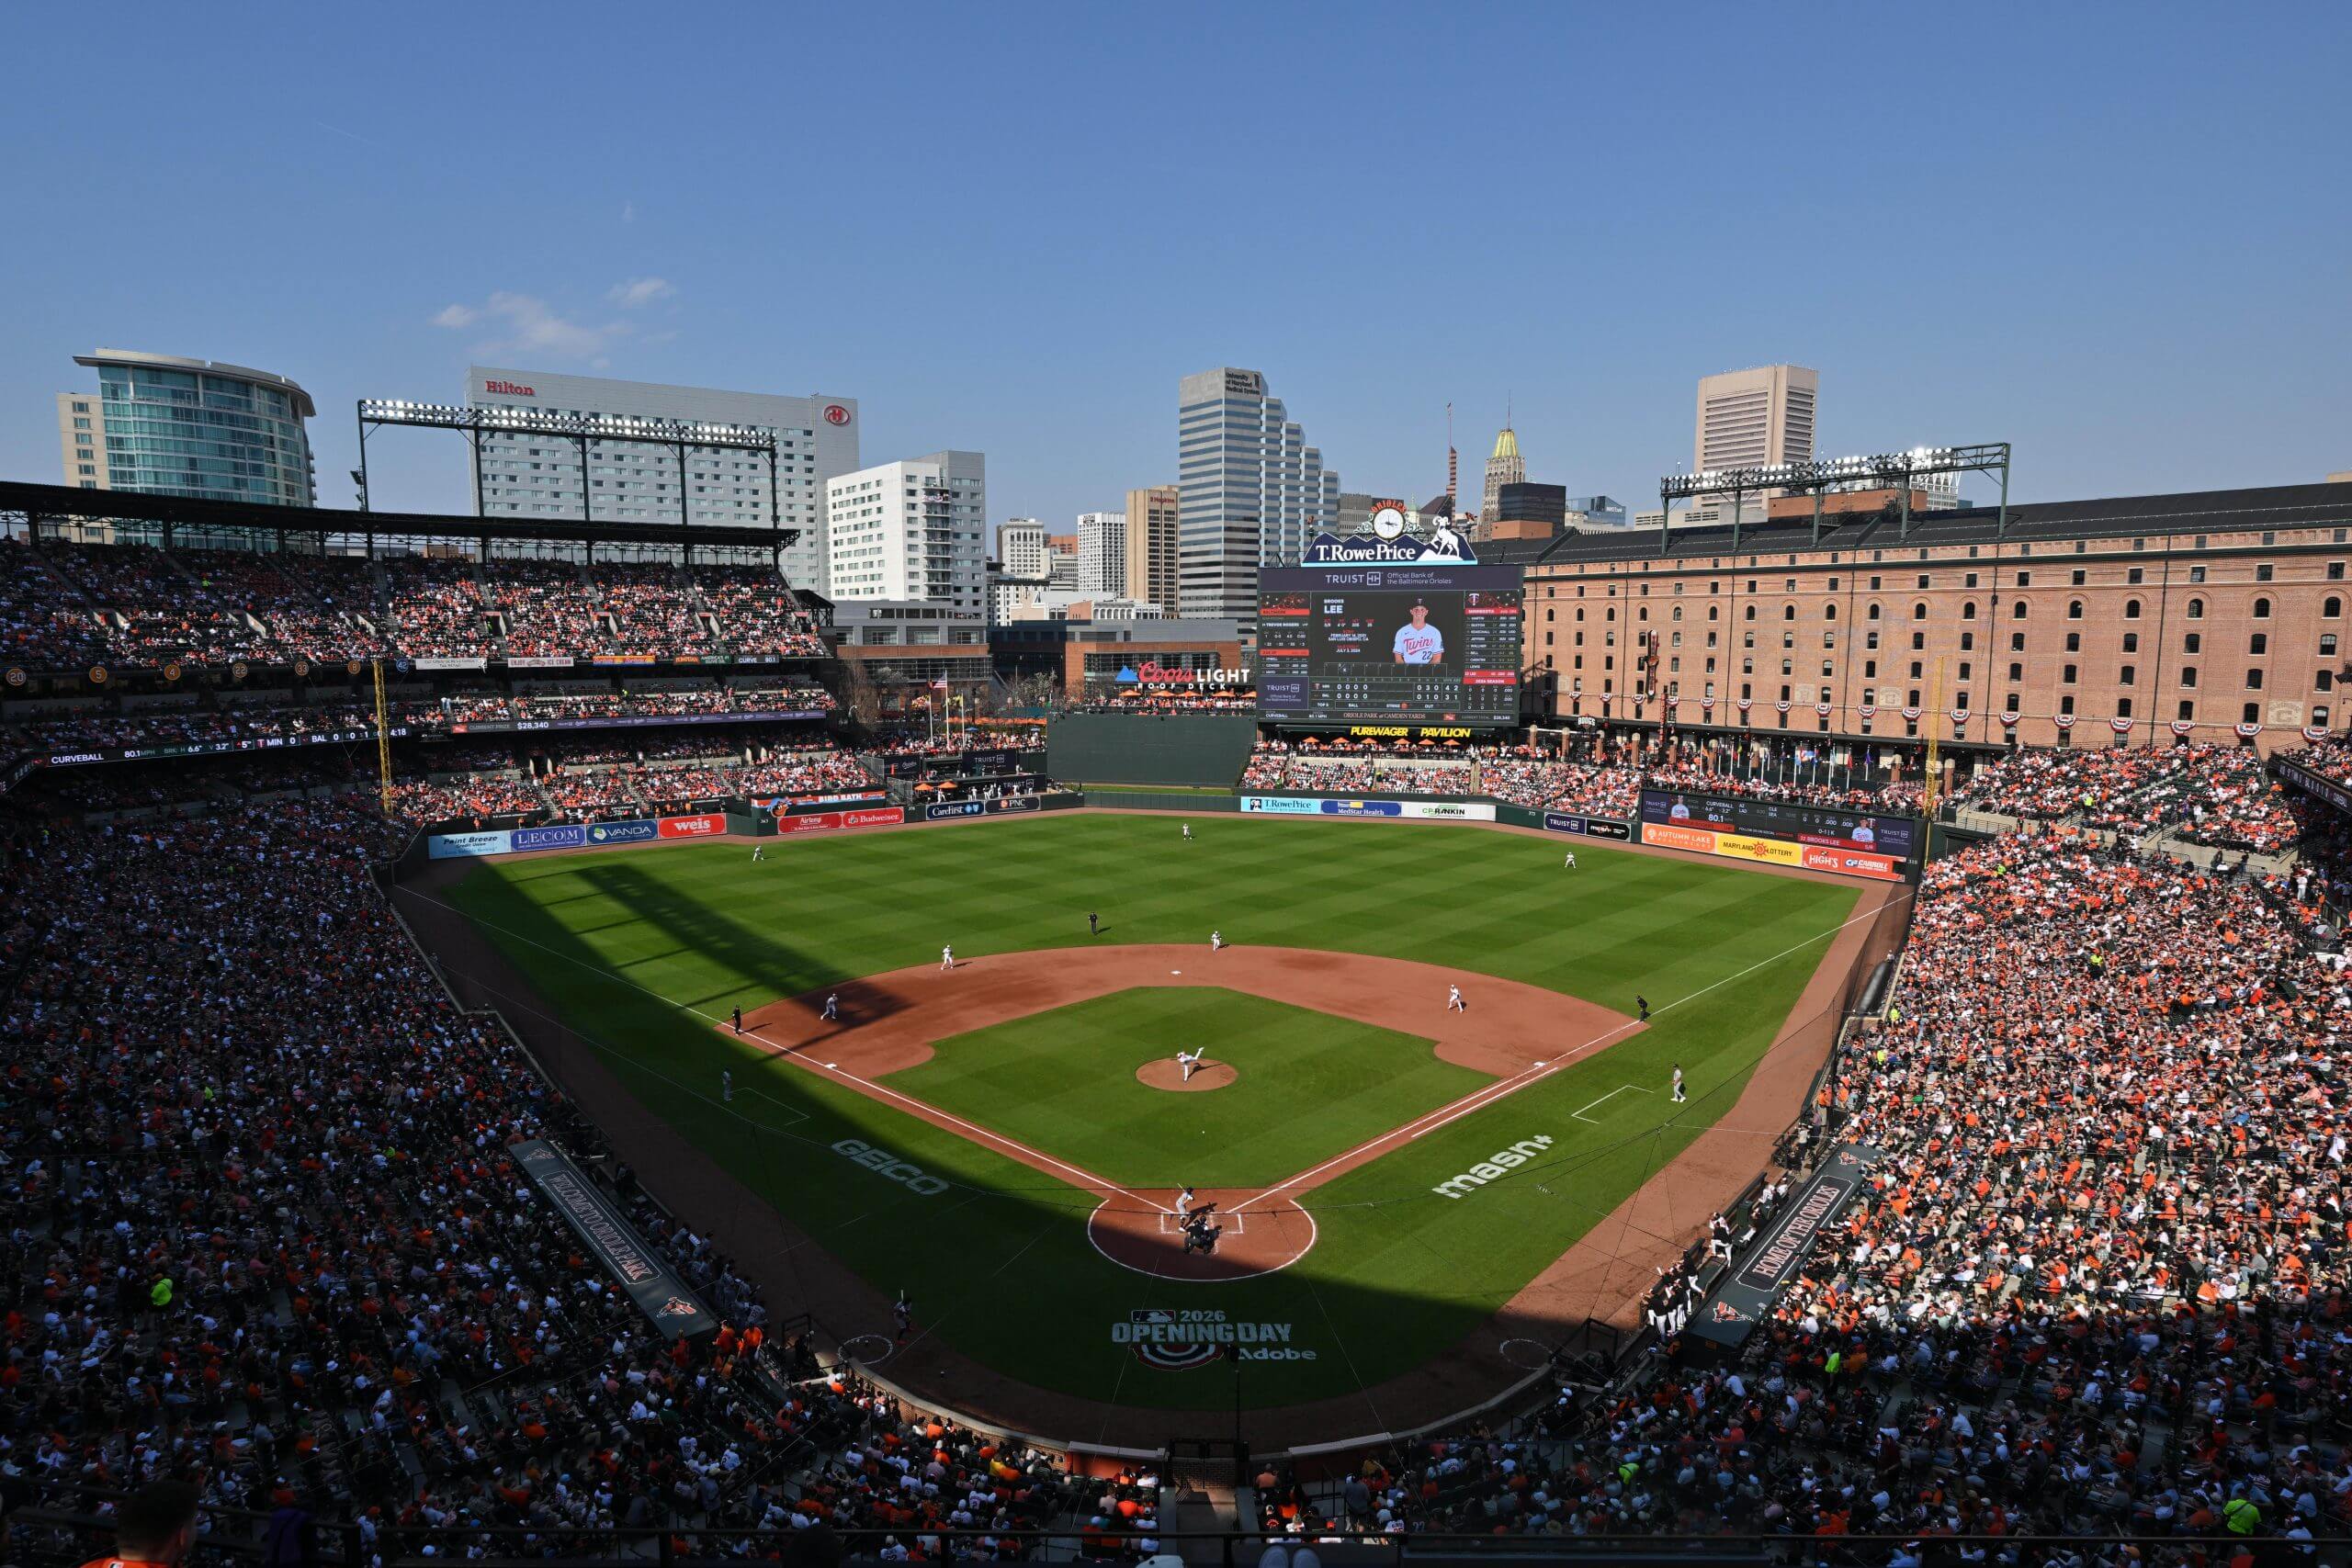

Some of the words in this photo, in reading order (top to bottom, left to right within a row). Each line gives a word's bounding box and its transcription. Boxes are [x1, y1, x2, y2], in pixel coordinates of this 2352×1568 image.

[485, 380, 536, 396] Hilton
[1371, 500, 1408, 513] ORIOLES
[1375, 544, 1416, 560] Price
[1326, 574, 1364, 584] TRUIST
[1324, 605, 1343, 614] LEE
[1404, 637, 1433, 655] Twins
[1421, 650, 1432, 660] 22
[234, 666, 246, 674] 22
[298, 664, 307, 672] 33
[1138, 661, 1193, 682] Coors
[1196, 669, 1250, 682] LIGHT
[10, 672, 24, 682] 20
[517, 721, 548, 730] $28,340
[266, 738, 283, 746] MIN
[289, 737, 296, 745] 0
[311, 734, 327, 743] BAL
[390, 728, 407, 737] 4:18
[1351, 726, 1408, 738] PUREWAGER
[1420, 727, 1471, 738] PAVILION
[51, 753, 104, 764] CURVEBALL
[818, 795, 839, 803] BIRD
[840, 794, 863, 802] BATH
[1009, 799, 1026, 807] PNC
[932, 805, 964, 817] CareFirst
[673, 818, 711, 830] weis
[860, 814, 899, 823] Budweiser
[1708, 814, 1724, 822] 80.1
[518, 829, 579, 844] LECOM
[607, 826, 652, 837] VANDA
[1658, 831, 1690, 840] AUTUMN
[1691, 835, 1712, 843] LAKE
[1807, 836, 1829, 844] BROOKS
[1724, 841, 1755, 852] MARYLAND
[1767, 849, 1792, 857] LOTTERY
[1809, 854, 1838, 868] HIGH'S
[1858, 860, 1889, 869] CARROLL
[831, 1139, 950, 1194] GEICO
[1800, 1185, 1840, 1220] ORIOLES
[1783, 1216, 1815, 1237] THE
[1776, 1233, 1801, 1249] OF
[614, 1245, 653, 1280] PARK
[1752, 1246, 1793, 1278] HOME
[1180, 1310, 1227, 1322] 2026
[1112, 1322, 1234, 1343] OPENING
[1238, 1322, 1292, 1342] DAY
[1238, 1347, 1317, 1360] Adobe
